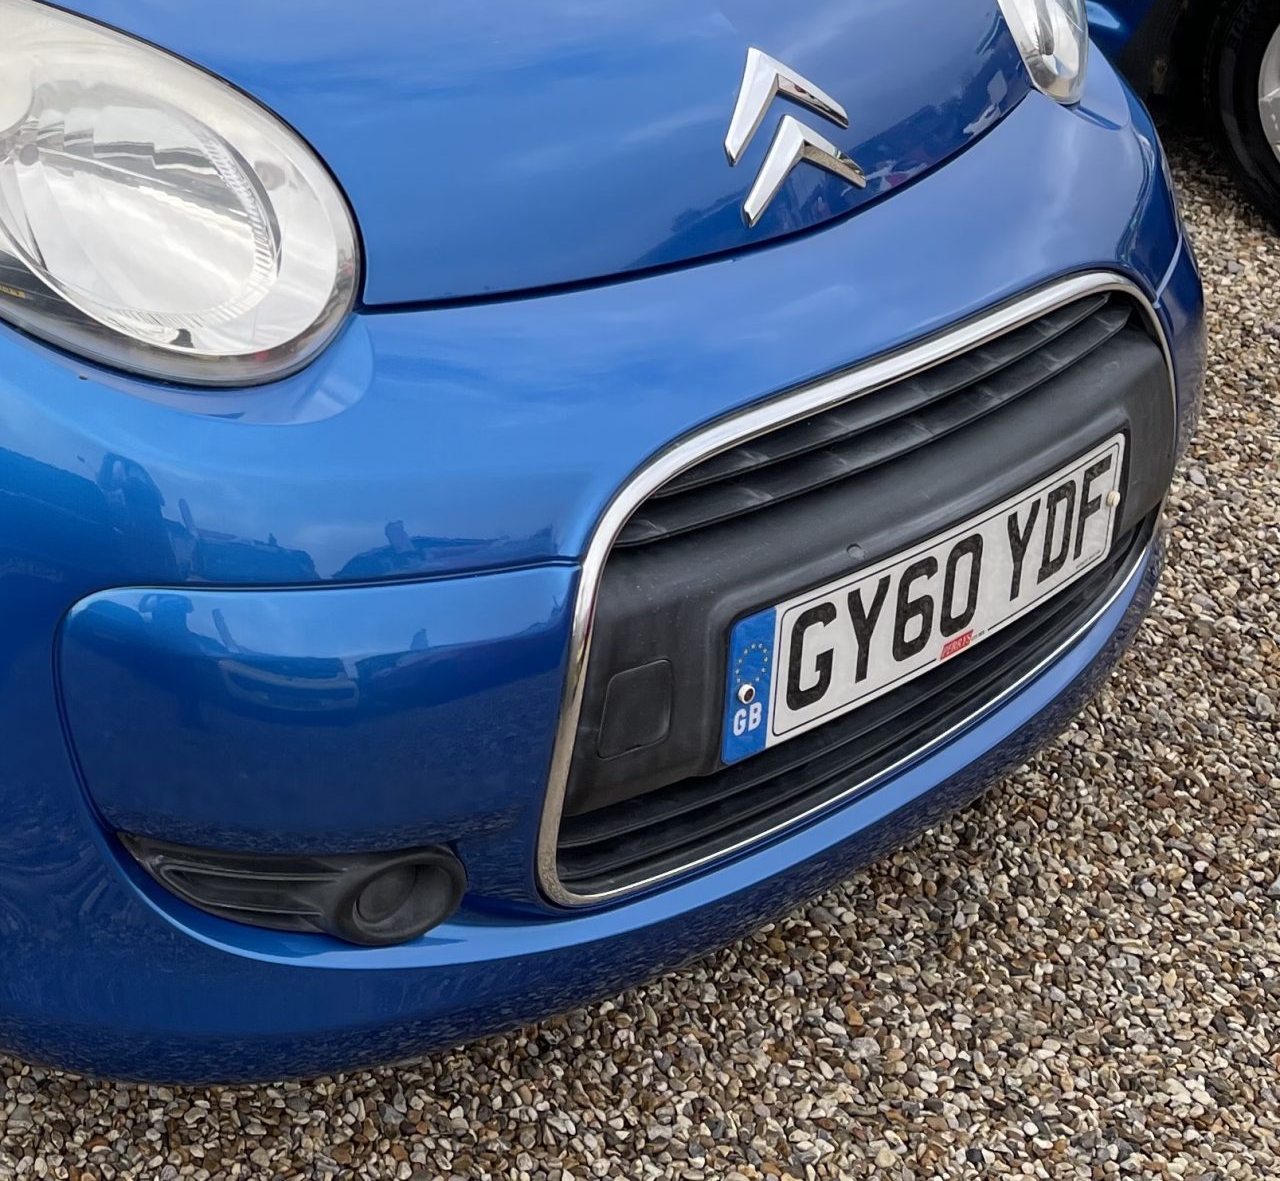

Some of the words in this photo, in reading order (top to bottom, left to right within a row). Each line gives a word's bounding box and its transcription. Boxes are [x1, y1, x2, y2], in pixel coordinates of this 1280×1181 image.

[785, 533, 984, 712] GY60
[1007, 453, 1113, 603] YDF
[733, 703, 762, 737] GB
